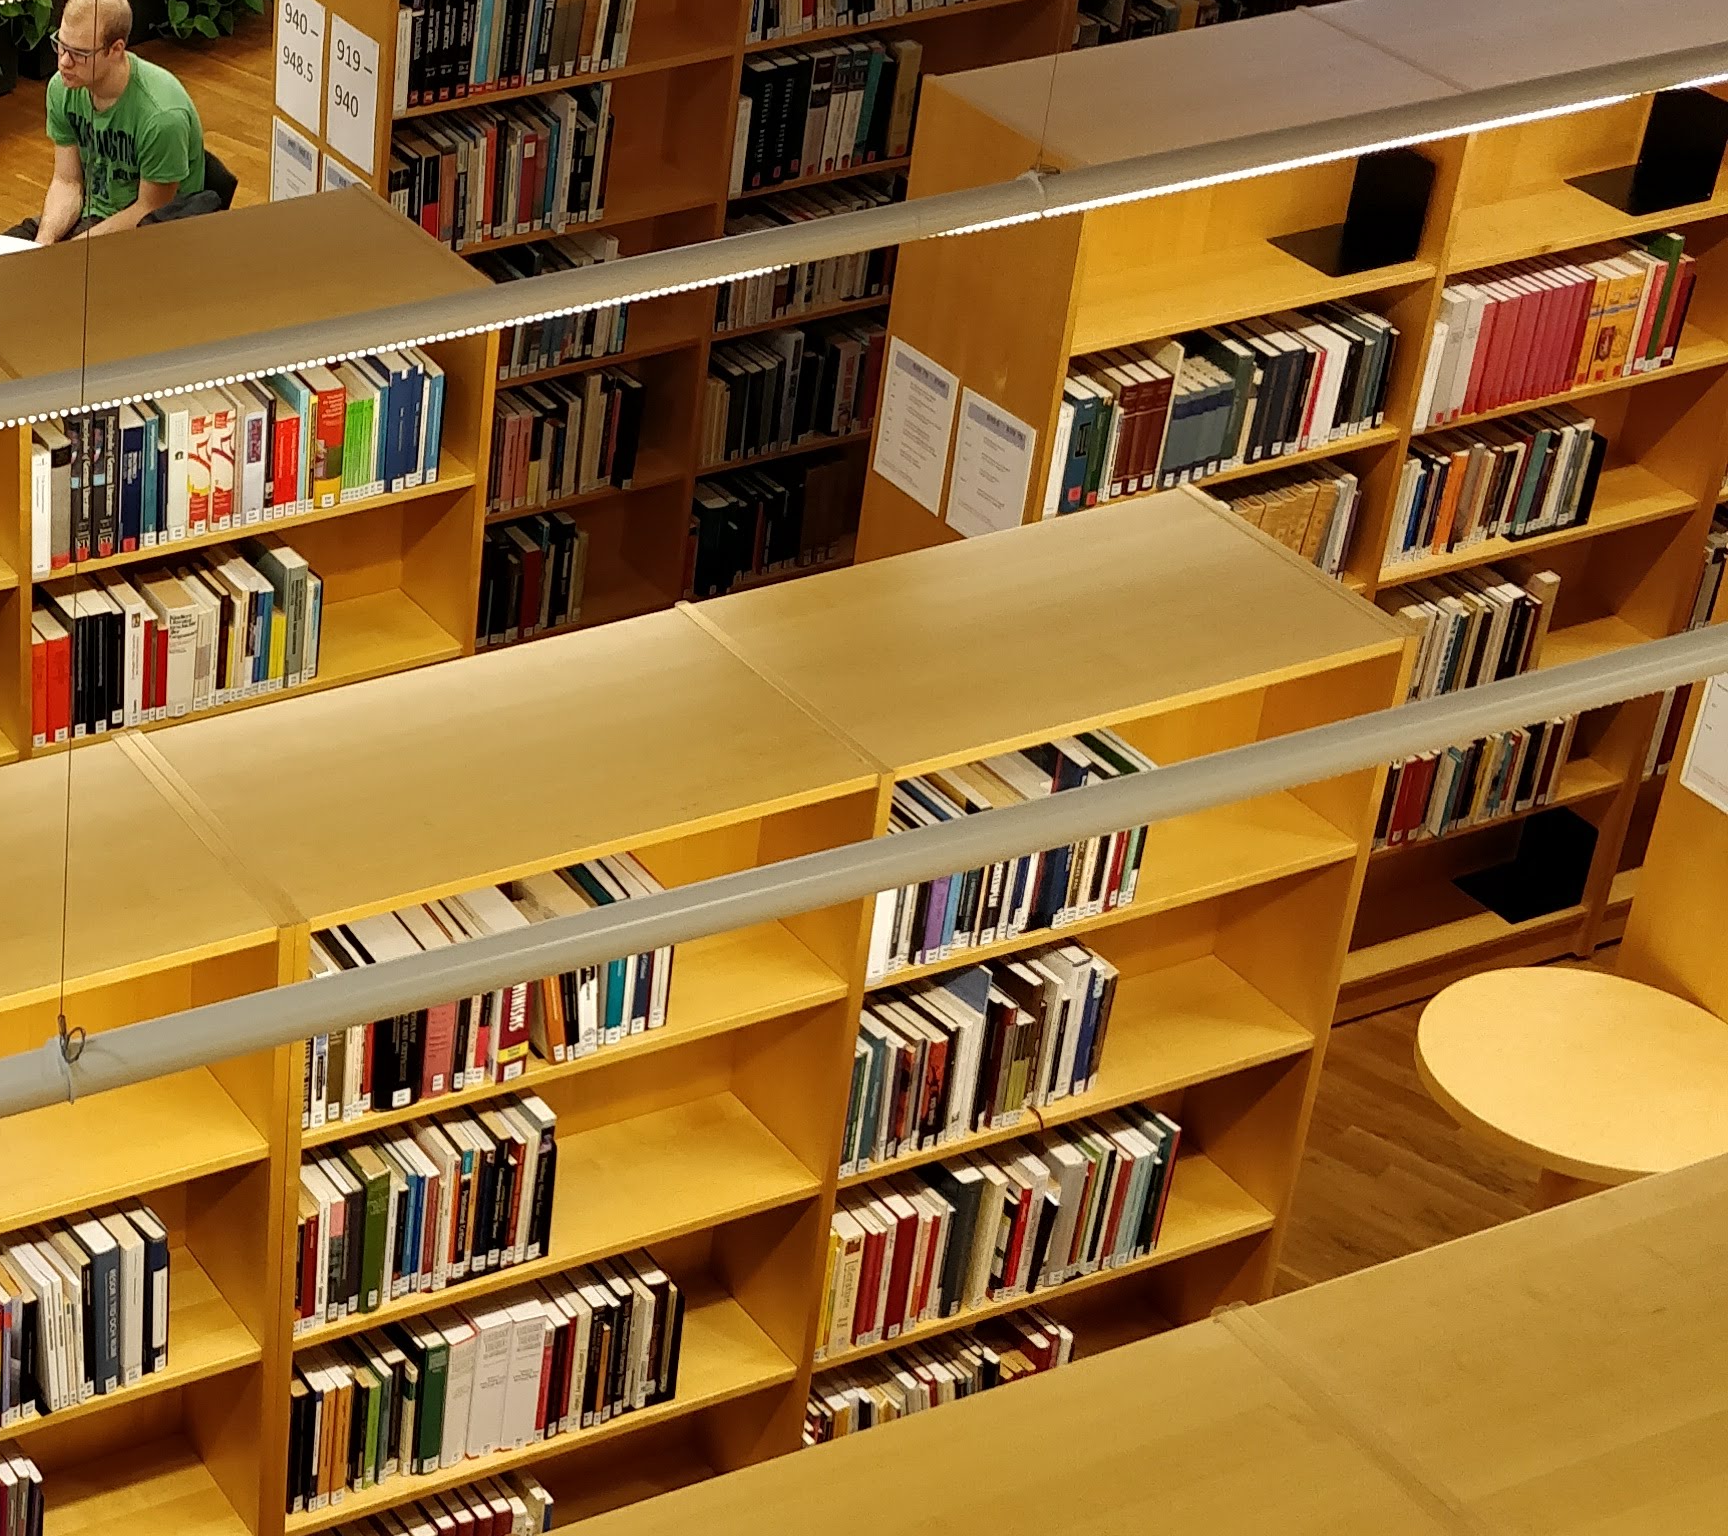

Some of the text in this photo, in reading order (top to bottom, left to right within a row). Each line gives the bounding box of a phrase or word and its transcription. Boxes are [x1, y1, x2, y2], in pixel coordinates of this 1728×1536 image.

[284, 2, 308, 36] 940
[282, 45, 314, 83] 948.5
[336, 38, 361, 72] 919
[333, 84, 359, 118] 940
